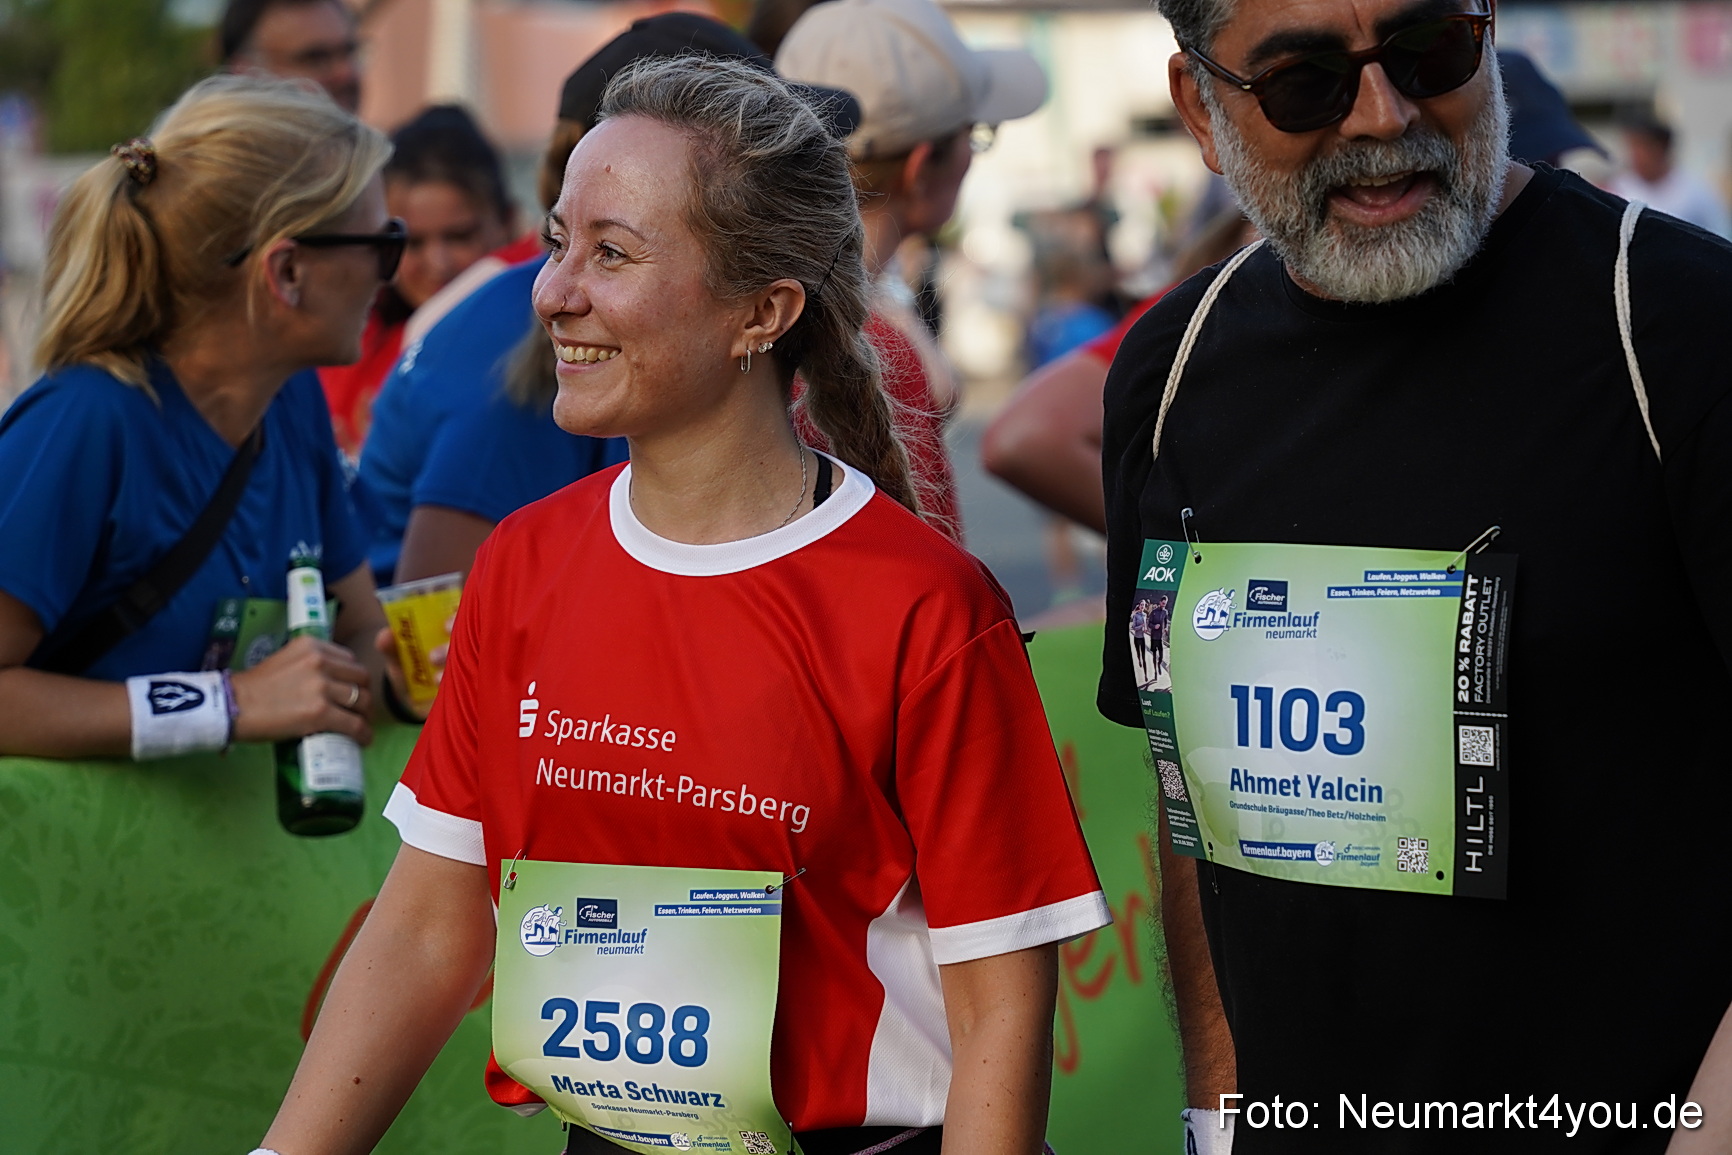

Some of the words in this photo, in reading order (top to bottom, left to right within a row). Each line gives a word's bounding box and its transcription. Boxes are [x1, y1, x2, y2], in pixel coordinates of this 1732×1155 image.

[1143, 566, 1177, 583] AOK
[1367, 572, 1392, 581] Laufen,
[1393, 572, 1418, 582] Joggen,
[1419, 572, 1446, 580] Walken
[1253, 589, 1286, 602] Fischer
[1330, 589, 1351, 597] Essen,
[1351, 589, 1376, 597] Trinken,
[1377, 588, 1399, 596] Feiern,
[1400, 588, 1441, 596] Netzwerken
[1459, 574, 1479, 653] RABATT
[1477, 576, 1493, 634] OUTLET
[1233, 611, 1320, 628] Firmenlauf
[1266, 628, 1317, 639] neumarkt
[1458, 657, 1470, 672] %
[1474, 636, 1485, 703] FACTORY
[1458, 675, 1470, 703] 20
[1230, 684, 1365, 756] 1103
[544, 709, 677, 752] Sparkasse
[1230, 767, 1302, 798] Ahmet
[1306, 773, 1383, 803] Yalcin
[535, 757, 811, 834] Neumarkt-Parsberg
[1229, 800, 1267, 812] Grundschule
[1268, 804, 1326, 818] Bräugasse/Theo
[1326, 809, 1387, 822] Betz/Holzheim
[1465, 776, 1484, 872] HILTL
[1242, 843, 1312, 861] firmenlauf.bayern
[1336, 853, 1381, 862] Firmenlauf
[693, 892, 715, 900] Laufen,
[715, 892, 739, 900] Joggen,
[740, 891, 766, 899] Walken
[583, 907, 616, 919] Fischer
[657, 907, 677, 915] Essen,
[678, 907, 701, 915] Trinken,
[701, 907, 722, 915] Feiern,
[723, 906, 761, 914] Netzwerken
[564, 928, 648, 944] Firmenlauf
[597, 944, 645, 955] neumarkt
[540, 997, 711, 1068] 2588
[550, 1074, 623, 1100] Marta
[624, 1081, 726, 1108] Schwarz
[591, 1102, 628, 1113] Sparkasse
[628, 1106, 700, 1120] Neumarkt-Parsberg
